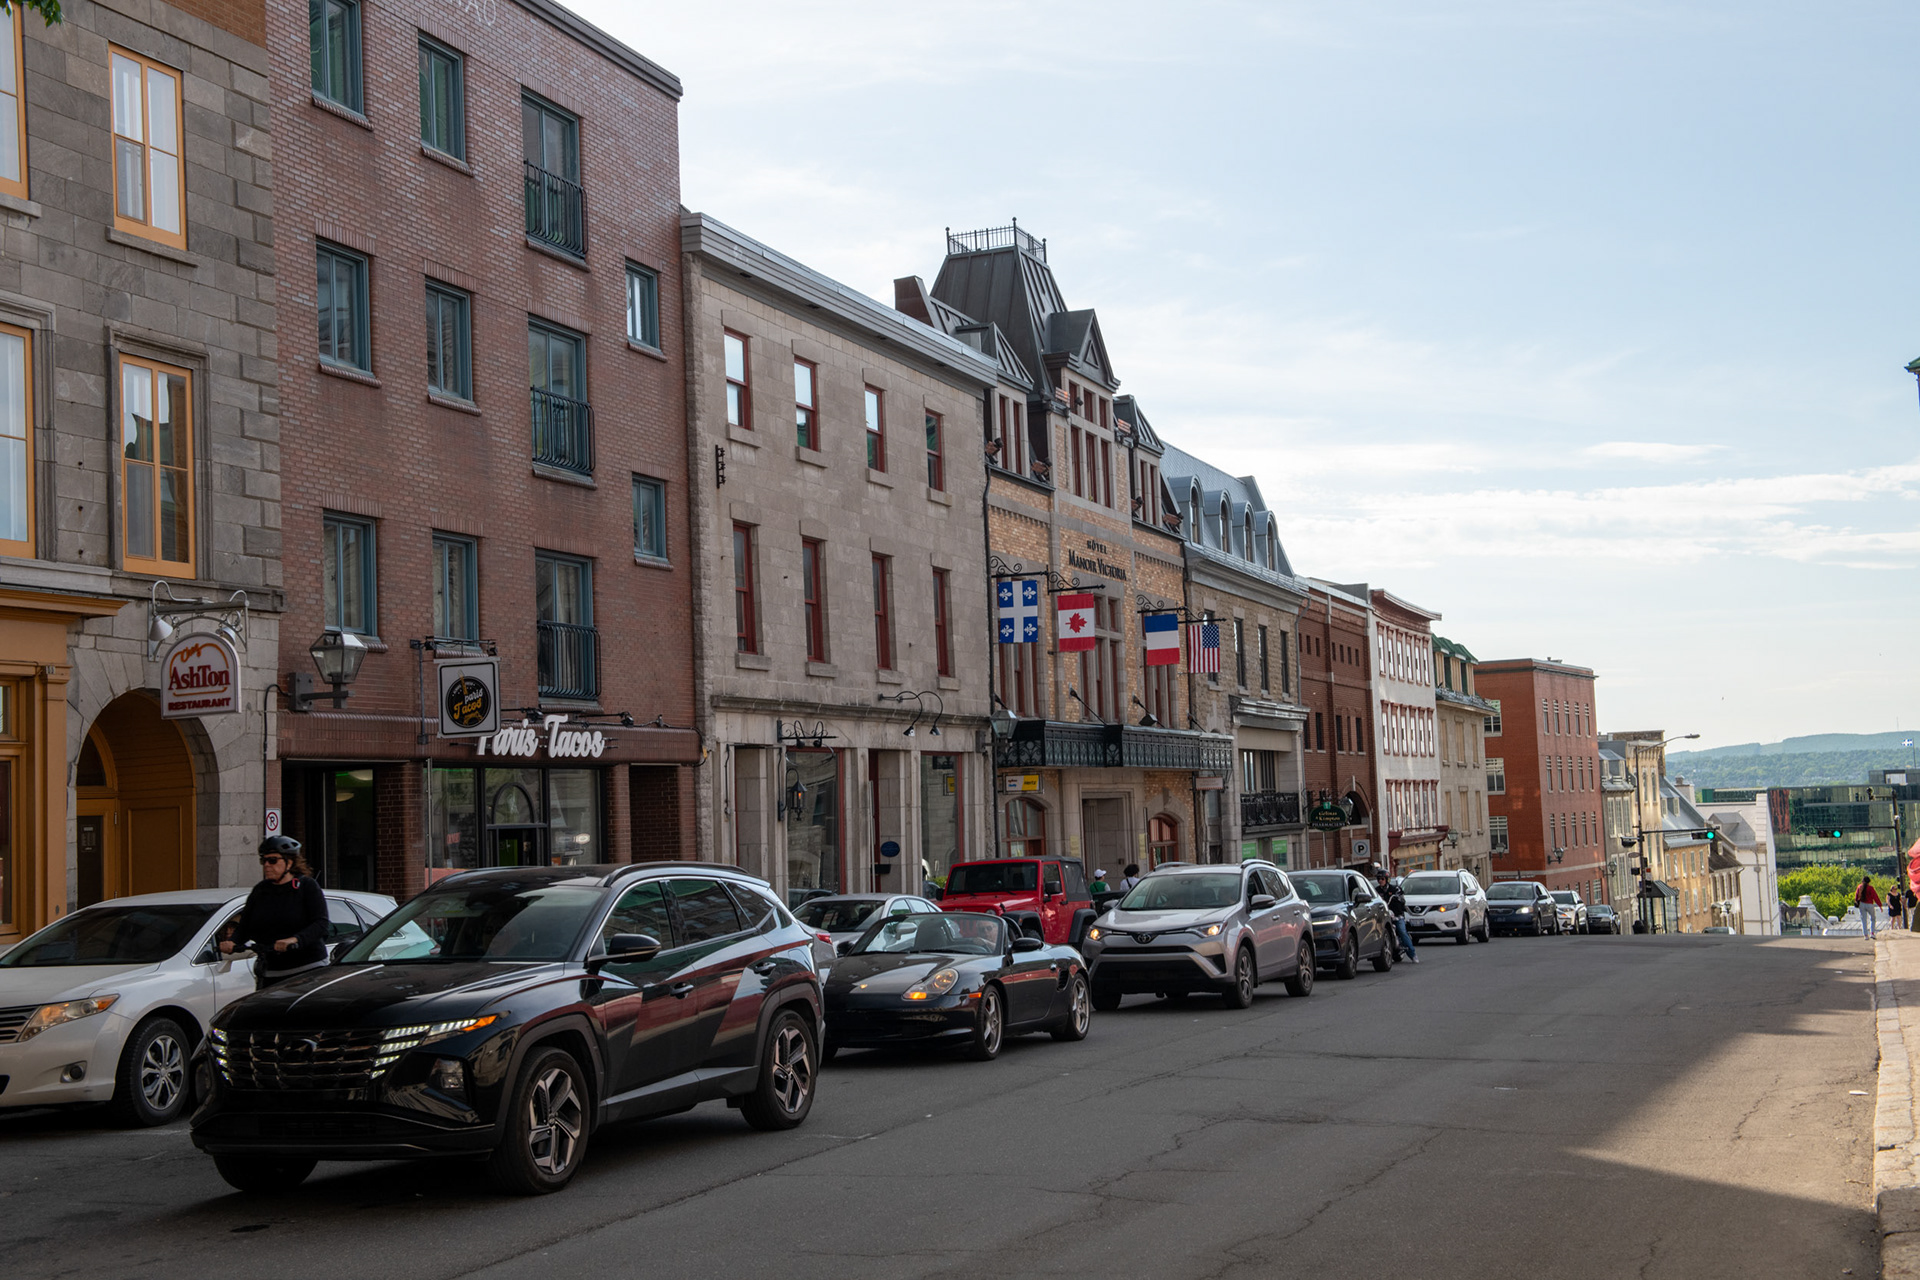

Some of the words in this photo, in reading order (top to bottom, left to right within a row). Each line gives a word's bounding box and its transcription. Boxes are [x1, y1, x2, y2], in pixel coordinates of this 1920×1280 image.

[168, 697, 232, 711] RESTAURANT
[544, 714, 605, 759] Tacos
[1357, 844, 1365, 854] P
